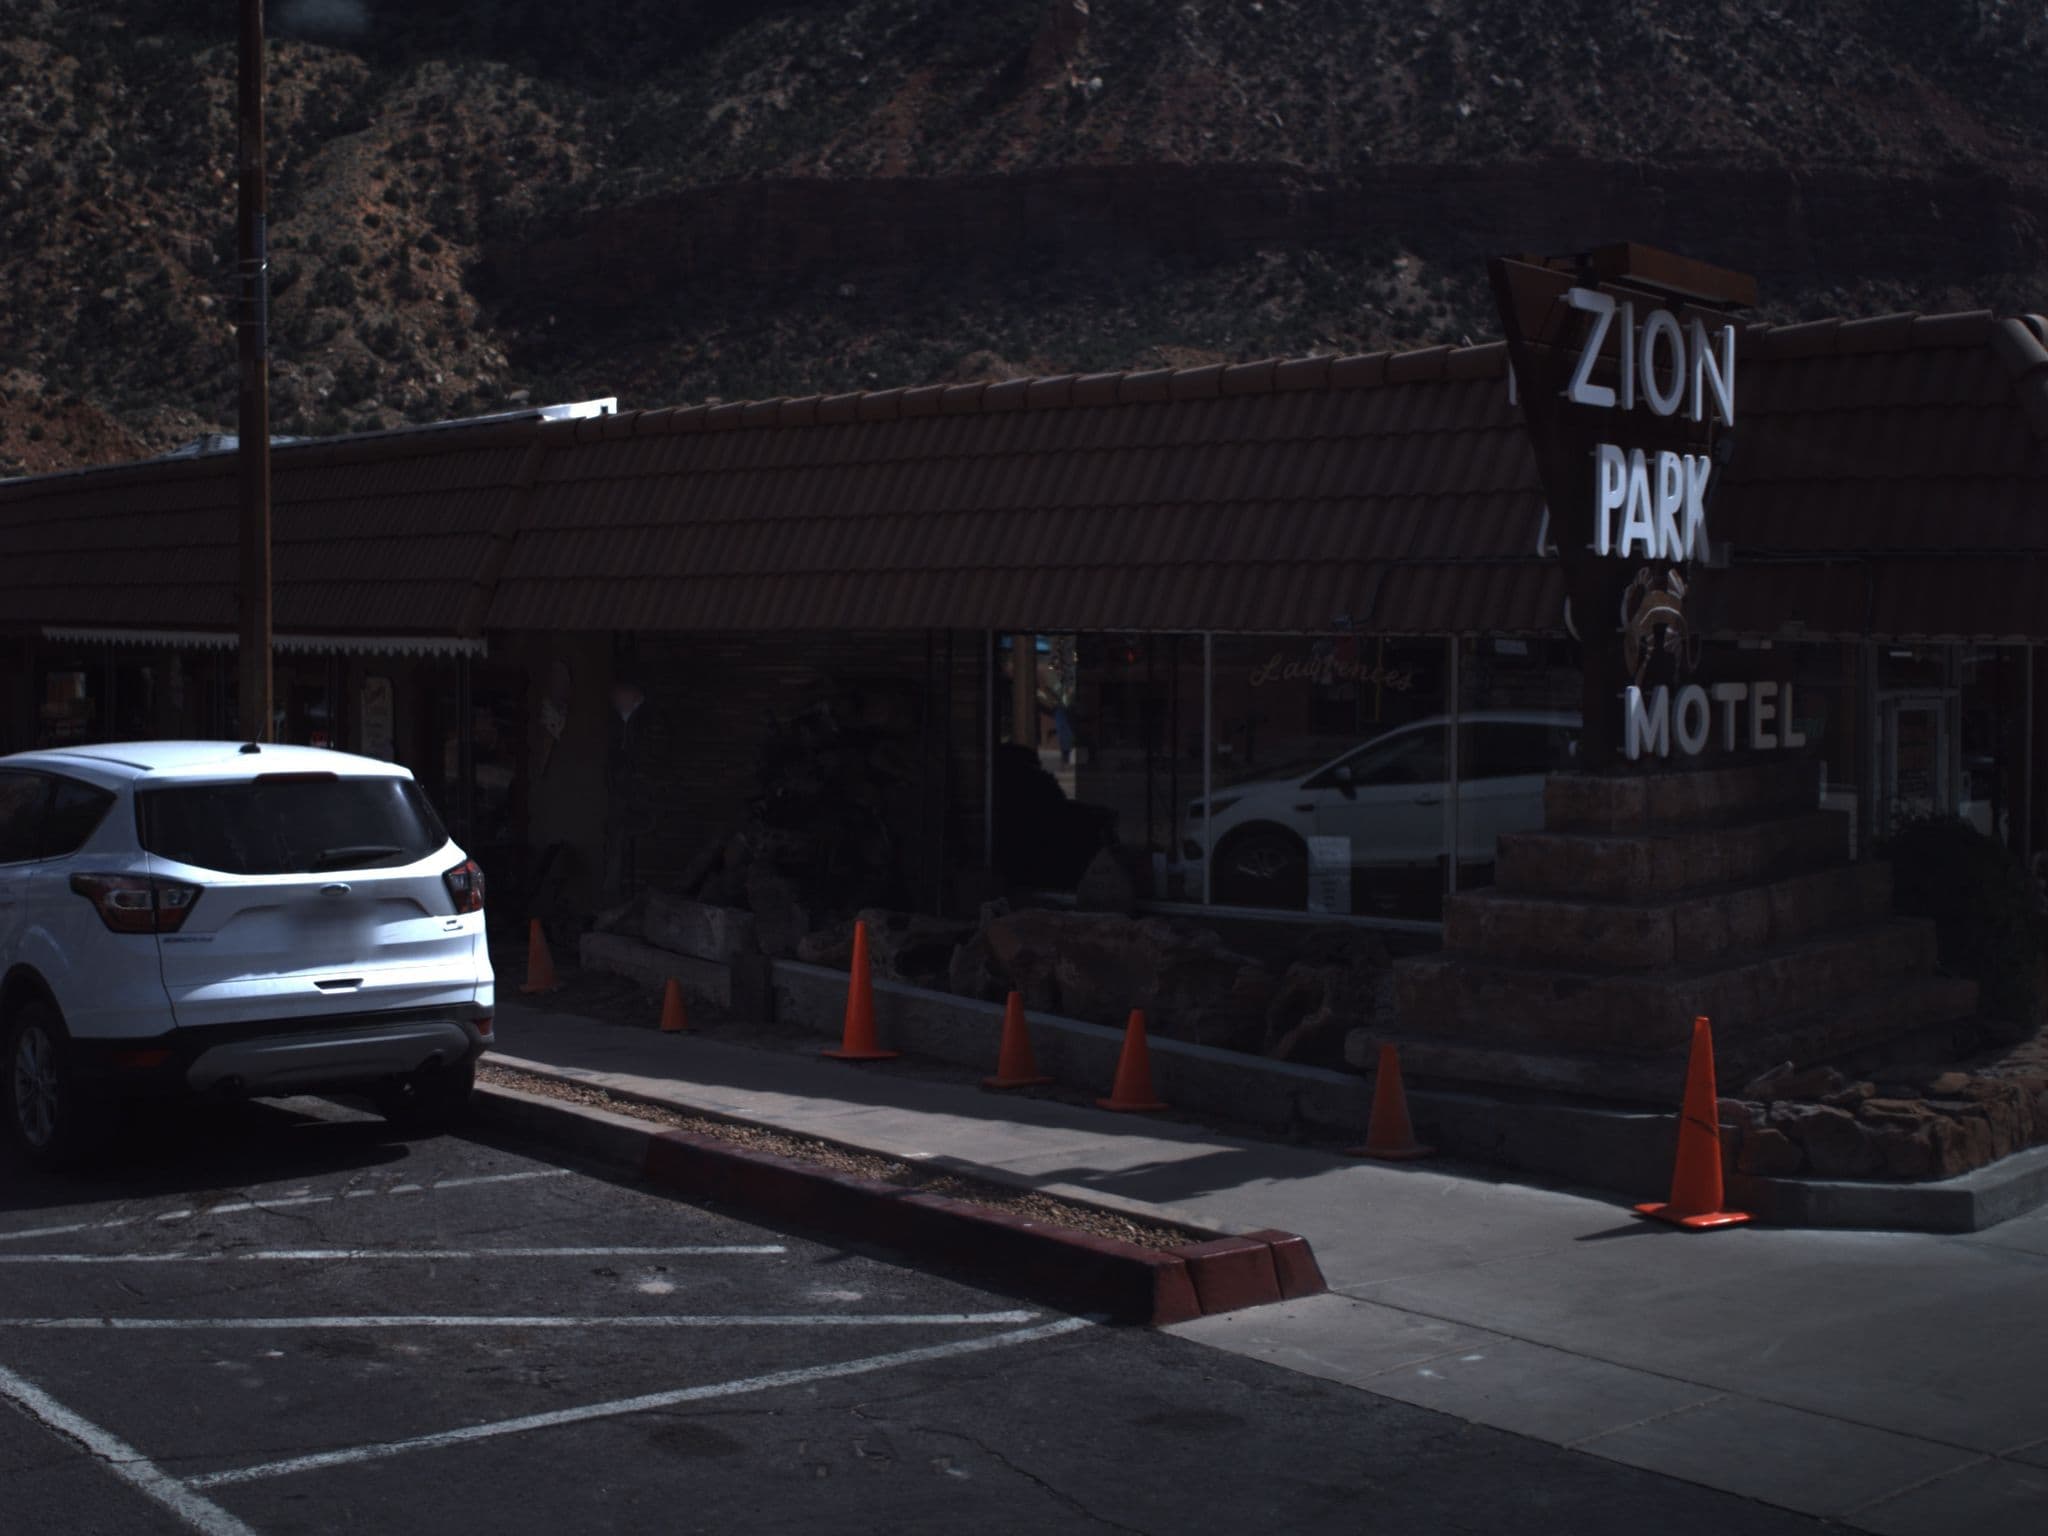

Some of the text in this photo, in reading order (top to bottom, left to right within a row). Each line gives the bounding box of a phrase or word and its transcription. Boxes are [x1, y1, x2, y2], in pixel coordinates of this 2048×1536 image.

[1567, 288, 1735, 427] ZION
[1594, 443, 1712, 562] PARK
[1624, 681, 1806, 760] MOTEL
